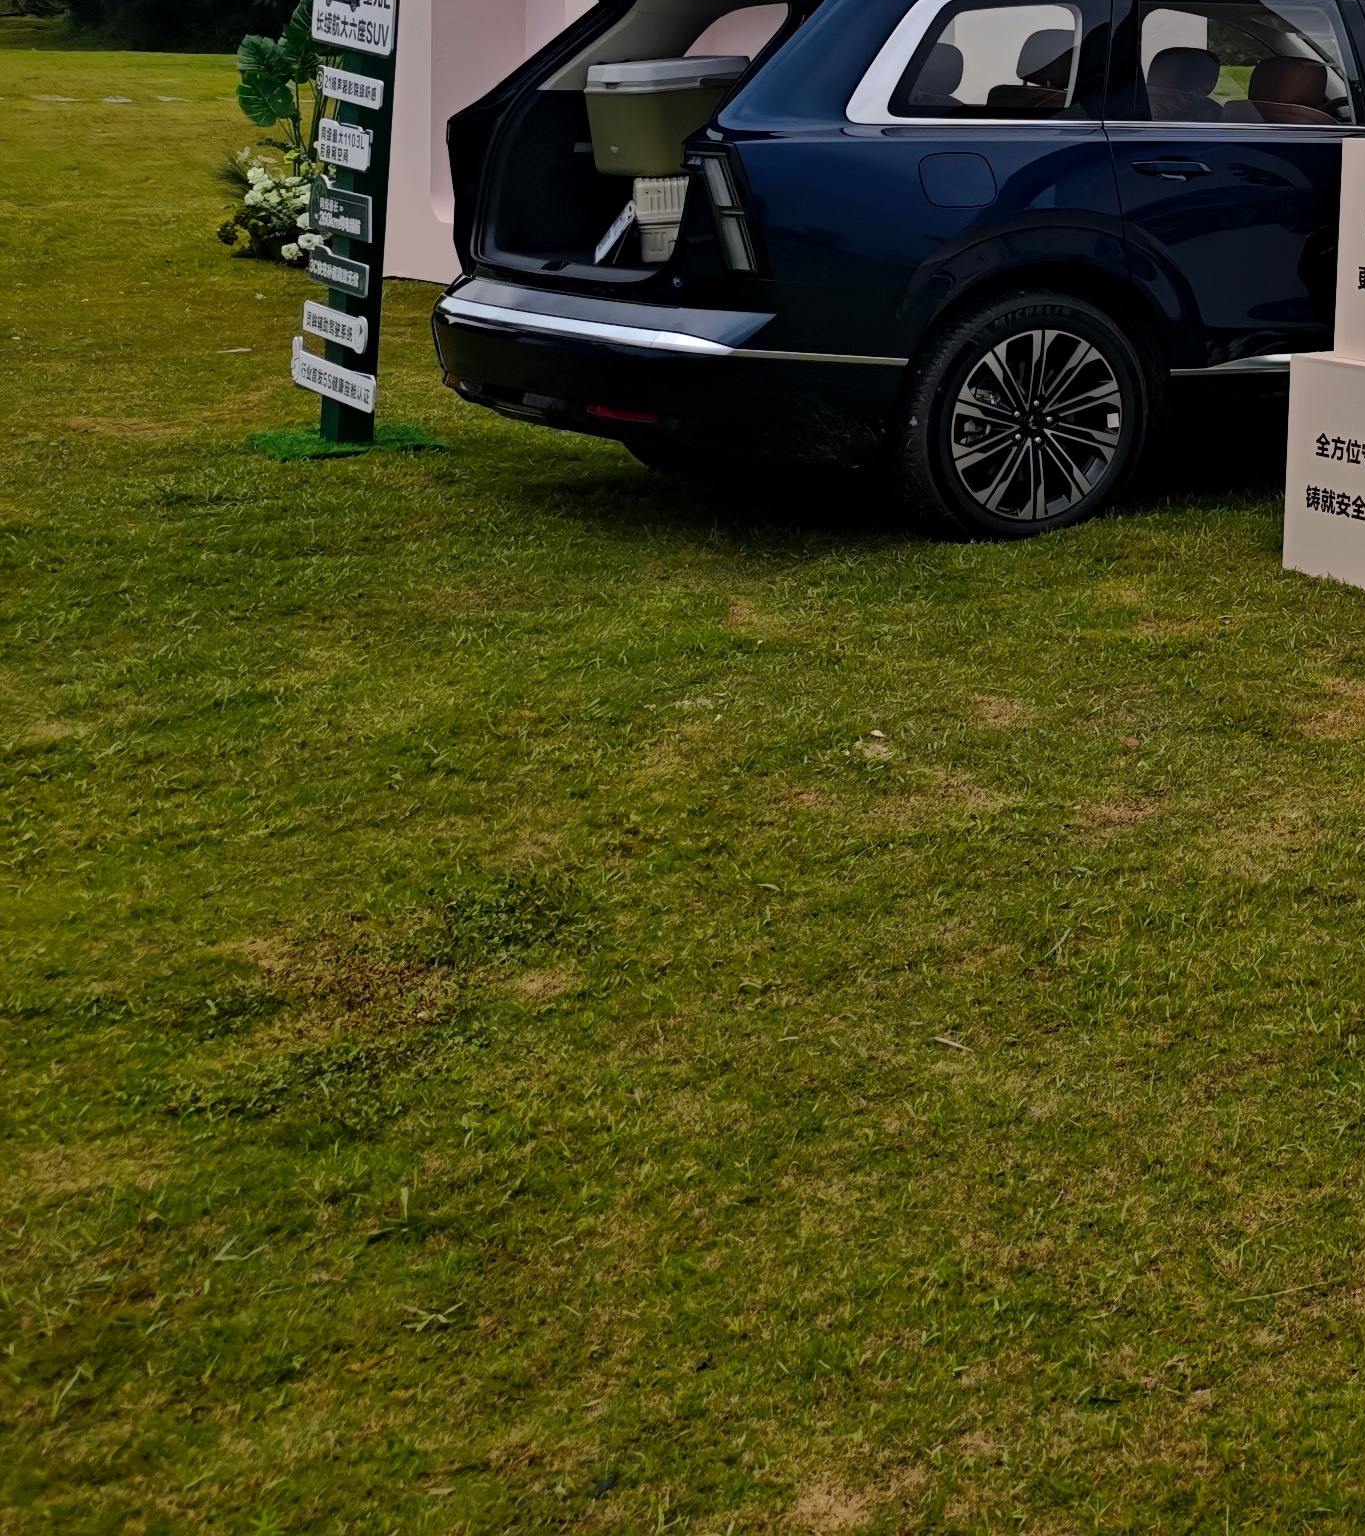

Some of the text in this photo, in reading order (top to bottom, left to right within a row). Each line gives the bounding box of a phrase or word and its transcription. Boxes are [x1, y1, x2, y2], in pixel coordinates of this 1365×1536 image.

[316, 8, 390, 48] 长续航大六座SUV
